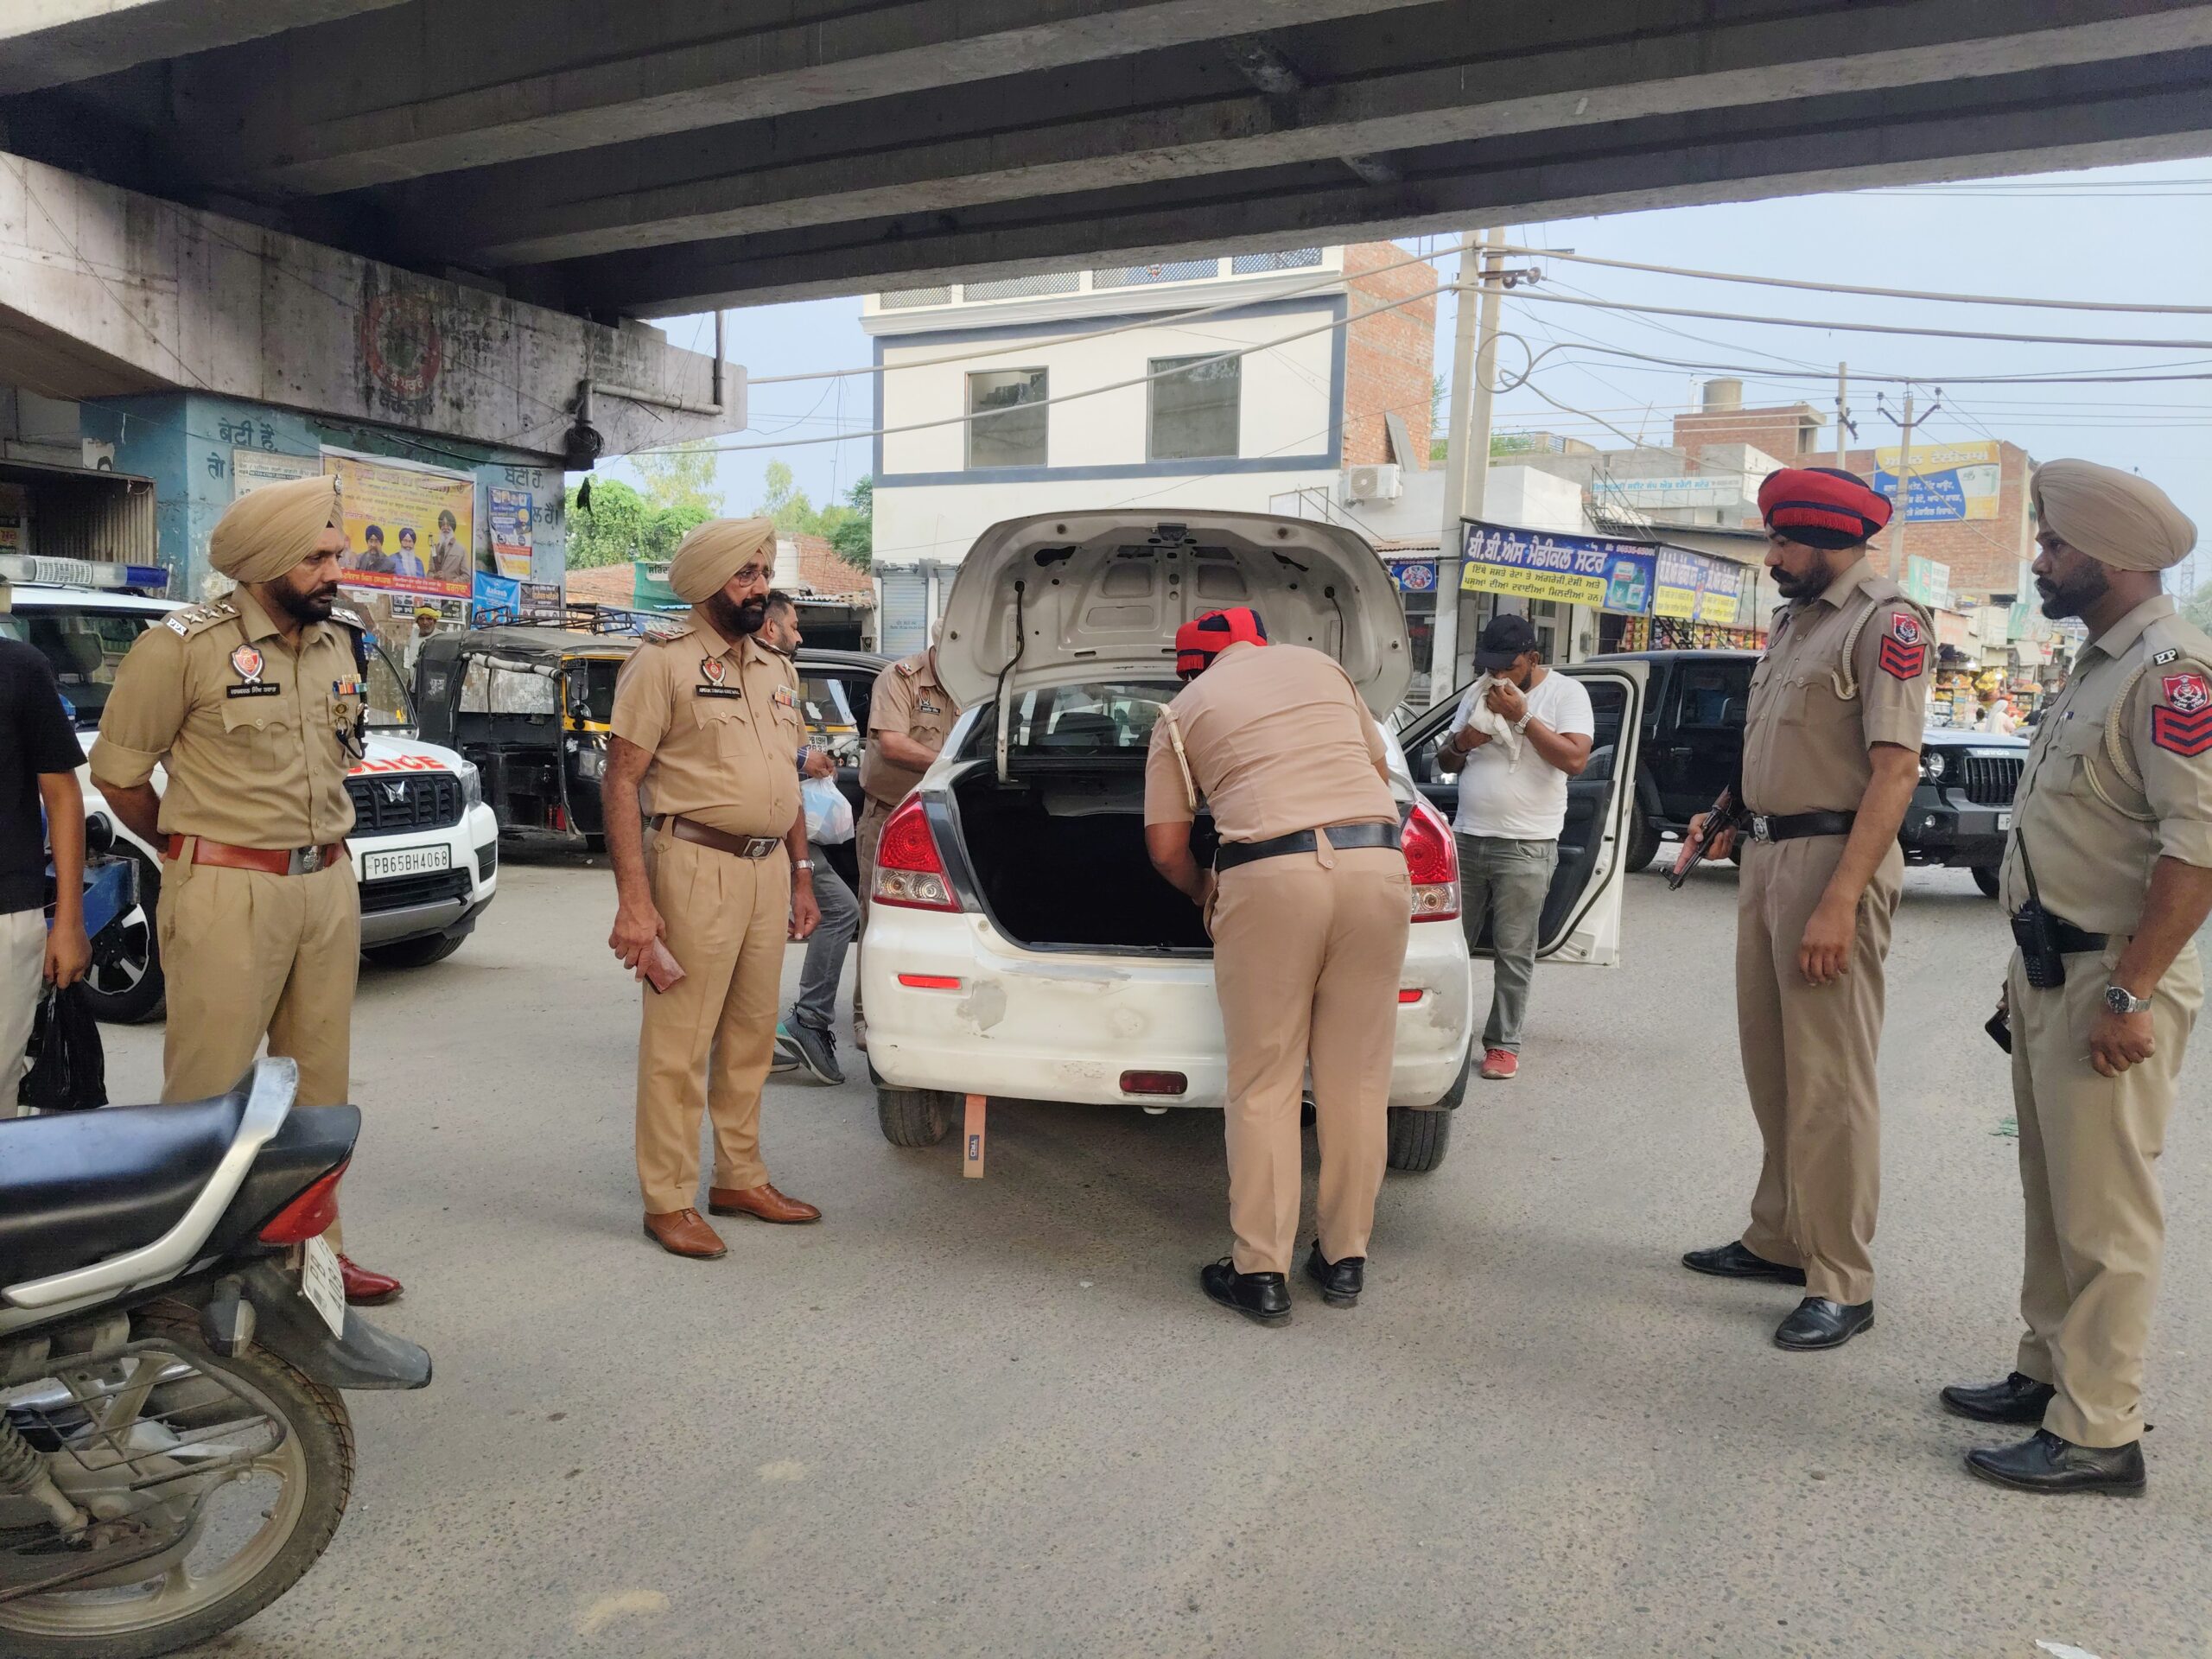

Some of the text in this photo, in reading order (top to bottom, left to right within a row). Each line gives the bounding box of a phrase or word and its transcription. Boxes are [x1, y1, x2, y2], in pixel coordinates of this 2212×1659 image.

[1526, 535, 1573, 569] ਮੈਡੀਕਲ
[1586, 579, 1600, 589] ਅਤੇ
[374, 850, 448, 875] PB65BH4068
